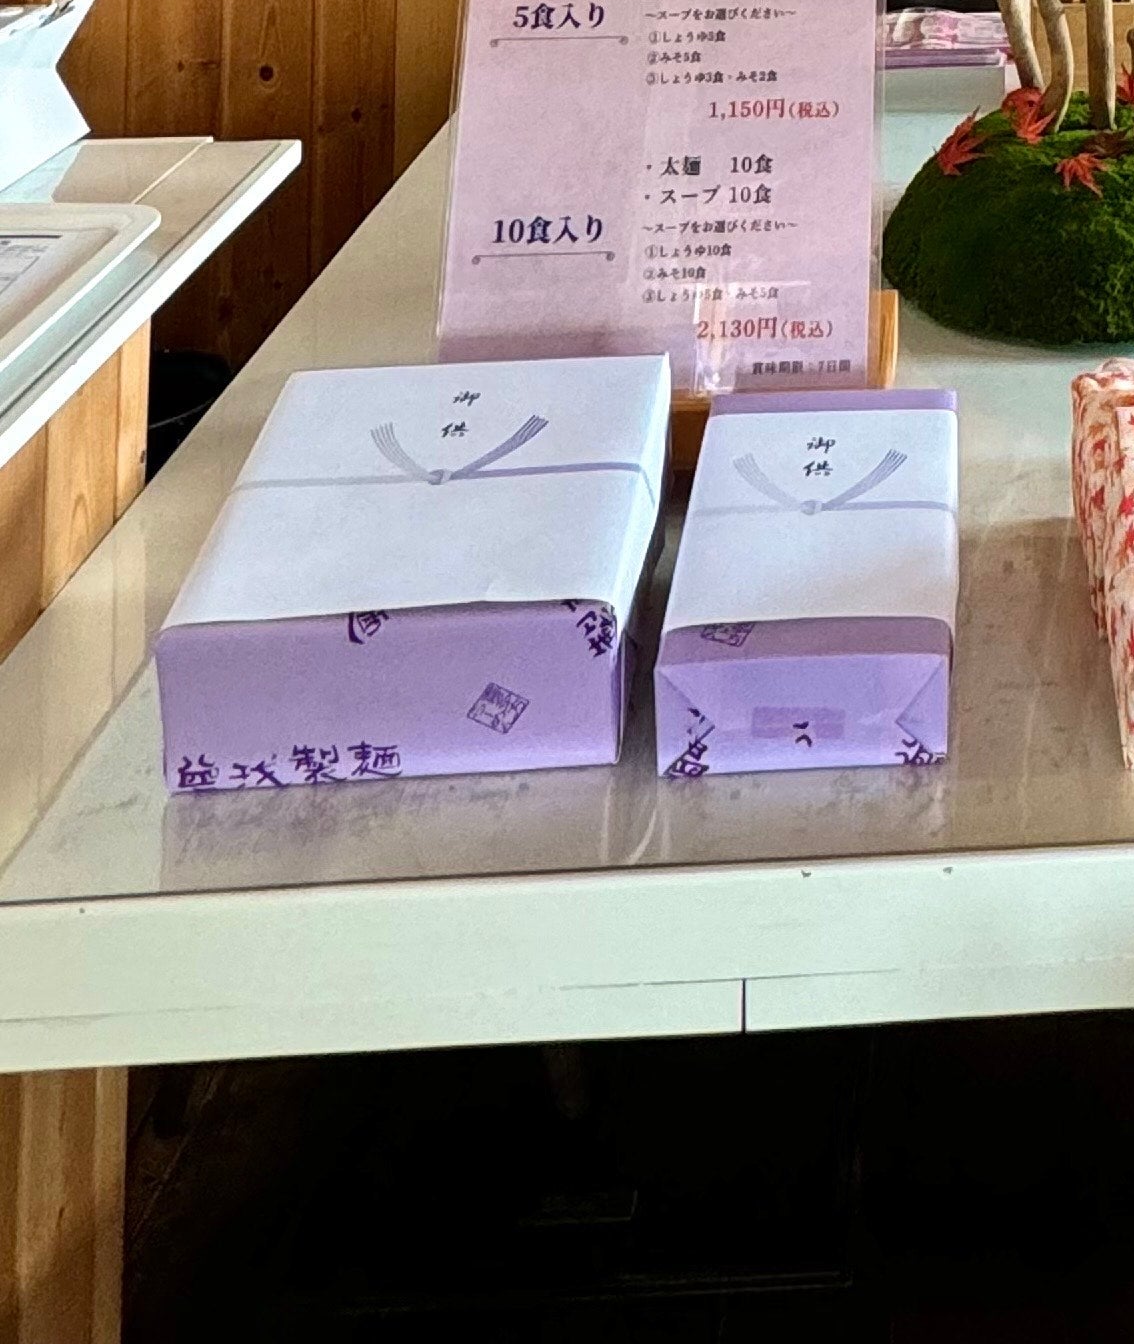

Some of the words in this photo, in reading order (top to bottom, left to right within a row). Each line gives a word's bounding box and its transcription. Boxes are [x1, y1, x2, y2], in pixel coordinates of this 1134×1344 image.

[513, 2, 606, 30] 5食入り
[492, 215, 604, 245] 10食入り
